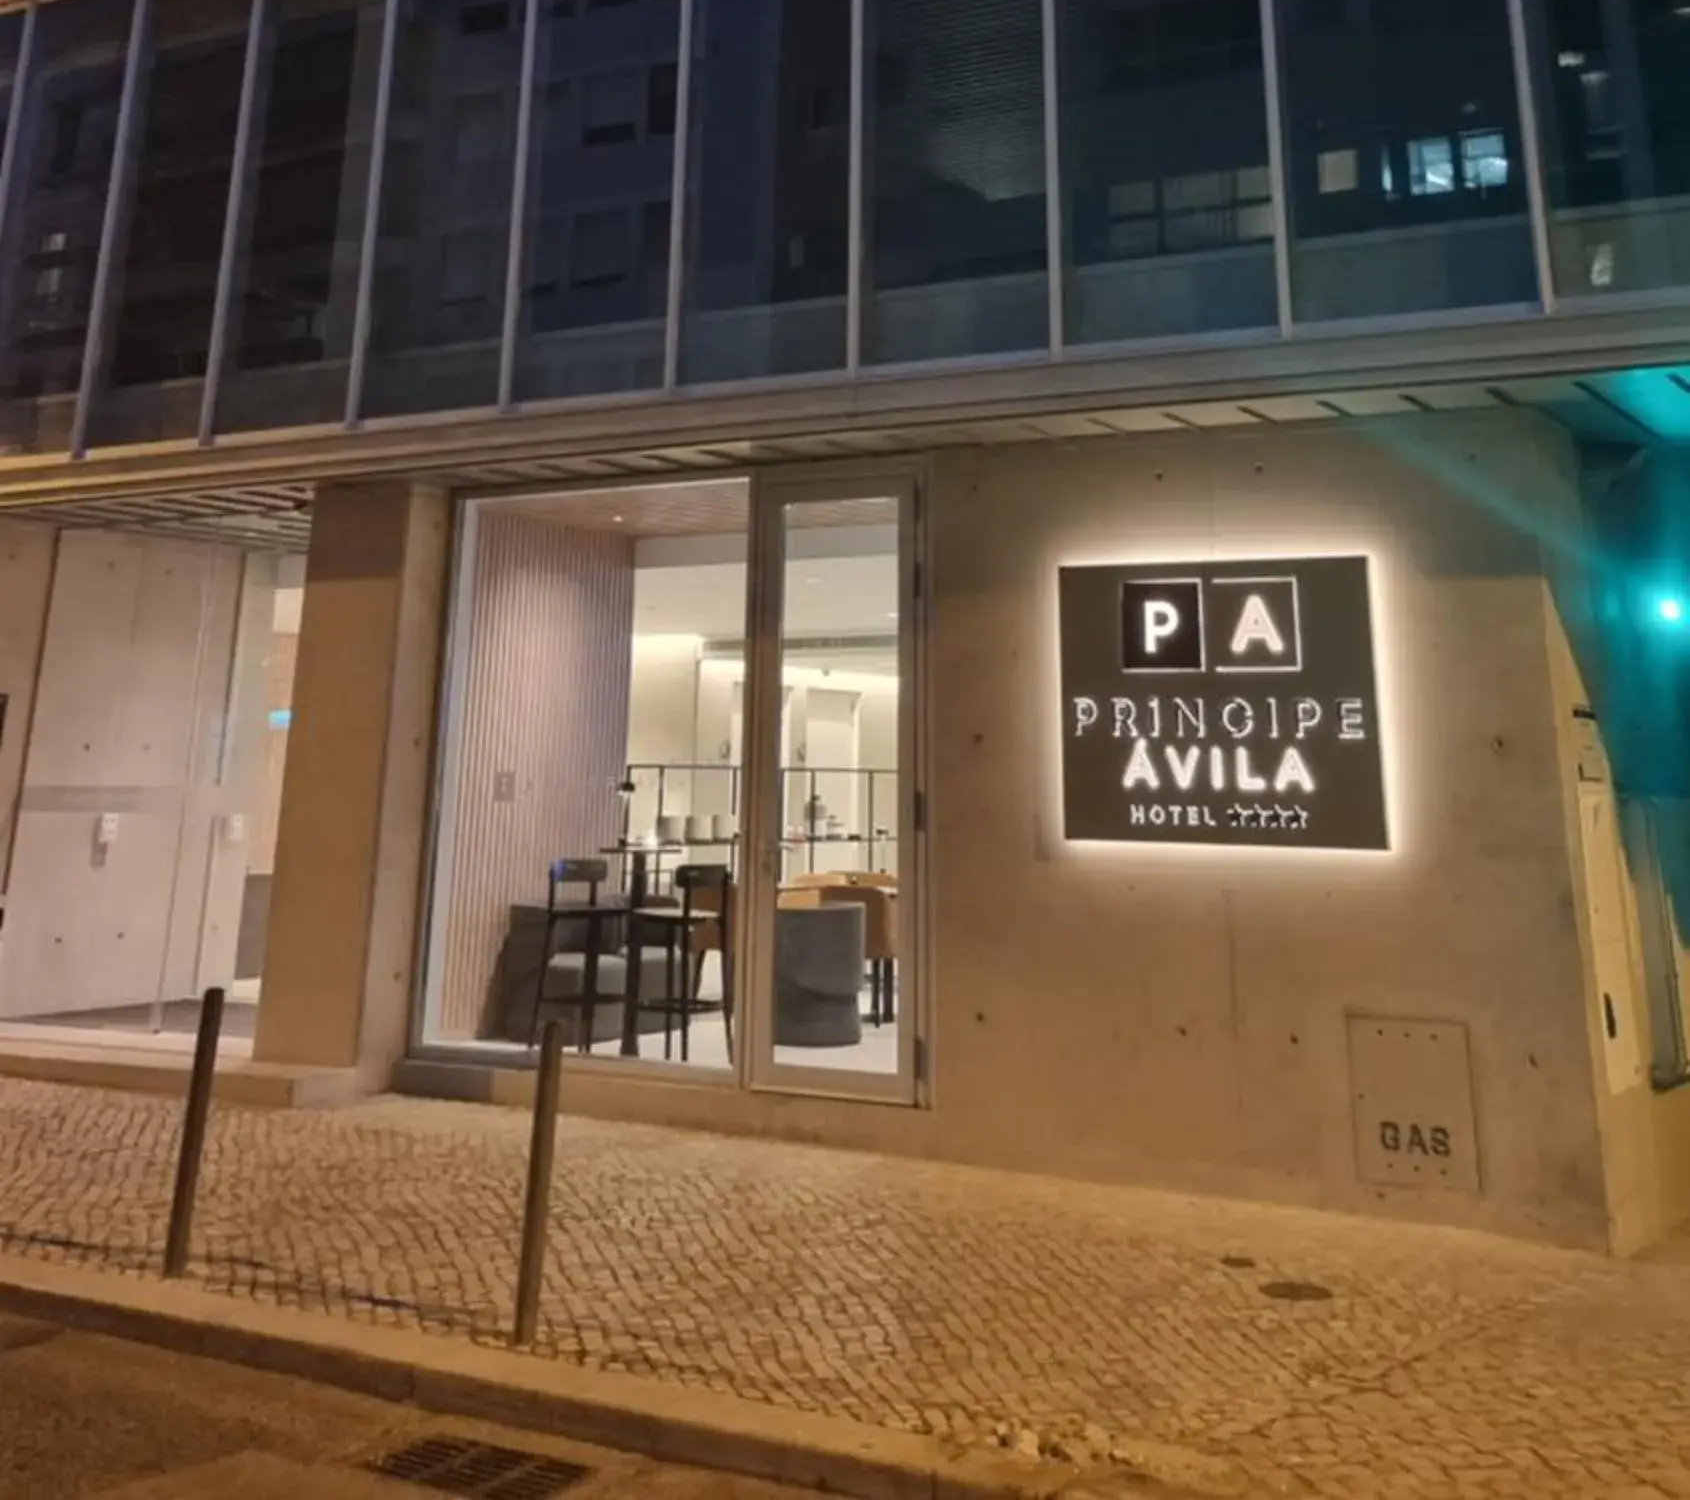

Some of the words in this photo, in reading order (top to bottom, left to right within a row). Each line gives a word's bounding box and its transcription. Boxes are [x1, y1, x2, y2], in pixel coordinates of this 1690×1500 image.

[1143, 600, 1179, 654] P
[1230, 594, 1284, 654] A
[1122, 738, 1315, 792] ÁVILA
[1129, 804, 1217, 827] HOTEL
[1379, 1120, 1452, 1158] GAS
